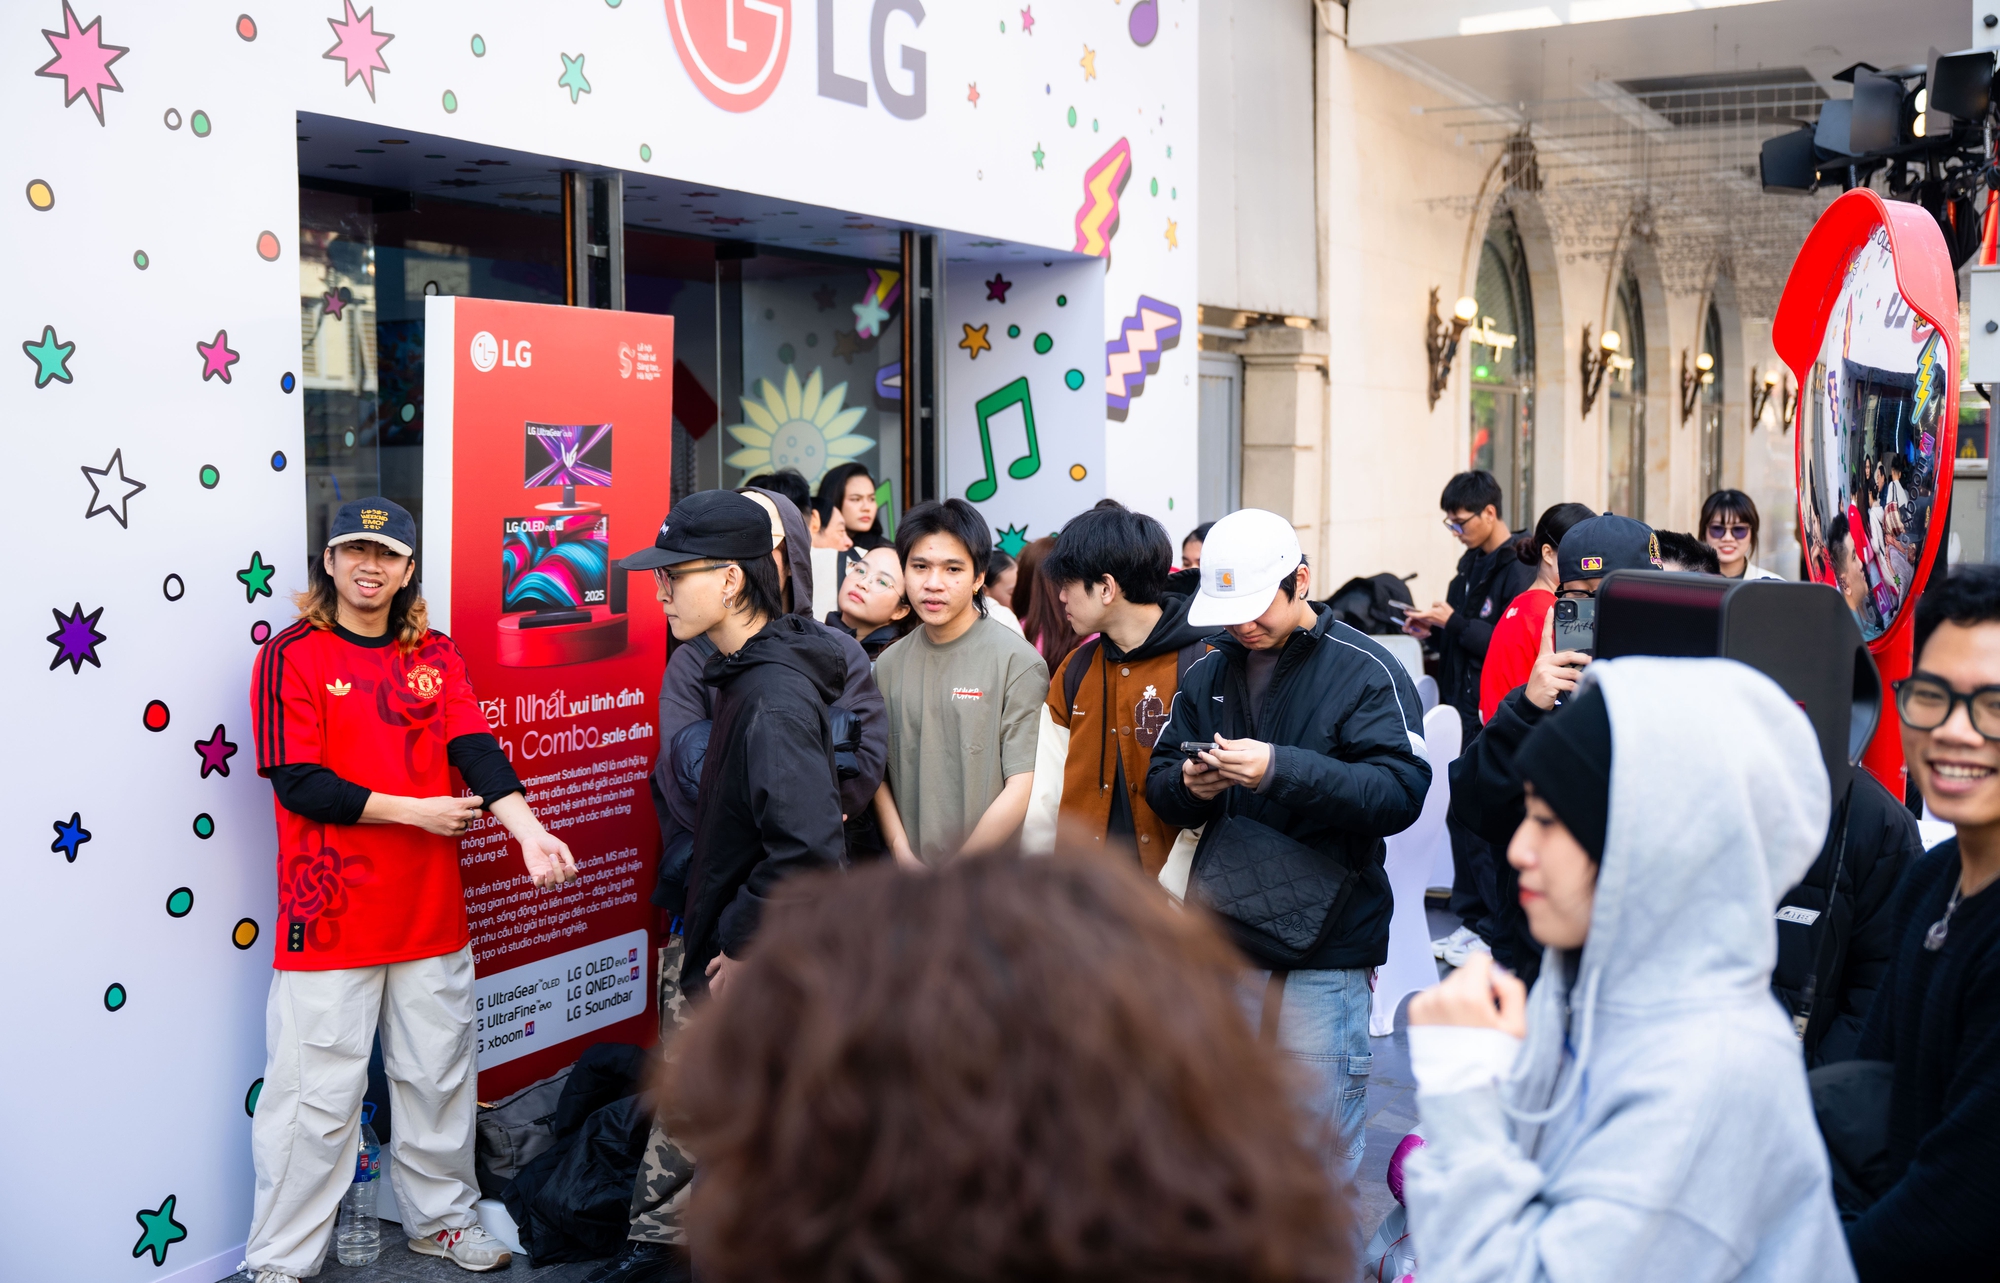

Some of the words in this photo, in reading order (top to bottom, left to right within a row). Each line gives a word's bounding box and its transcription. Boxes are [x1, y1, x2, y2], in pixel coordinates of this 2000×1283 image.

[816, 0, 927, 121] LG
[502, 339, 532, 369] LG
[527, 425, 536, 435] LG
[506, 521, 519, 533] LG
[520, 520, 545, 532] OLED
[584, 590, 605, 602] 2025
[479, 697, 508, 729] Tết
[516, 688, 567, 724] Nhất
[569, 695, 590, 715] vui
[591, 692, 615, 712] linh
[521, 724, 599, 760] Combo
[601, 727, 627, 745] sale
[520, 771, 561, 787] ertainment
[561, 766, 592, 780] Solution
[592, 760, 608, 775] (MS)
[609, 759, 617, 771] là
[628, 755, 640, 768] hội
[640, 755, 649, 766] tụ
[540, 788, 550, 801] thị
[582, 778, 595, 791] thế
[623, 771, 634, 783] LG
[561, 799, 571, 812] hệ
[571, 797, 587, 809] sinh
[588, 793, 602, 805] thái
[619, 787, 635, 799] hình
[461, 836, 485, 850] thông
[487, 831, 508, 844] minh,
[551, 817, 575, 830] laptop
[575, 812, 585, 823] và
[461, 853, 474, 867] nội
[475, 850, 496, 862] dung
[497, 845, 509, 858] số.
[512, 874, 521, 887] trí
[605, 850, 618, 862] MS
[629, 847, 638, 856] ra
[465, 902, 486, 914] hông
[487, 897, 505, 911] gian
[506, 892, 519, 904] nơi
[519, 888, 534, 901] mọi
[583, 874, 596, 885] tạo
[496, 910, 516, 922] sống
[517, 904, 537, 918] động
[538, 899, 548, 911] và
[563, 891, 584, 905] mạch
[621, 877, 635, 889] linh
[480, 932, 497, 943] nhu
[538, 914, 547, 927] trí
[547, 912, 558, 926] tại
[558, 910, 570, 924] gia
[586, 901, 600, 913] các
[600, 896, 614, 909] môi
[482, 949, 496, 961] tạo
[497, 943, 507, 955] và
[508, 937, 532, 952] studio
[533, 928, 561, 944] chuyên
[567, 966, 582, 983] LG
[585, 956, 614, 976] OLED
[614, 957, 628, 967] evo
[629, 949, 638, 962] AI
[476, 997, 484, 1012] G
[541, 977, 560, 991] OLED
[567, 985, 582, 1002] LG
[585, 974, 616, 996] QNED
[616, 975, 630, 986] evo
[631, 967, 639, 980] AI
[477, 1018, 484, 1032] G
[538, 1001, 553, 1012] evo
[566, 1005, 582, 1022] LG
[585, 990, 633, 1016] Soundbar
[477, 1038, 484, 1054] G
[487, 1029, 524, 1050] xboom
[525, 1022, 534, 1035] AI
